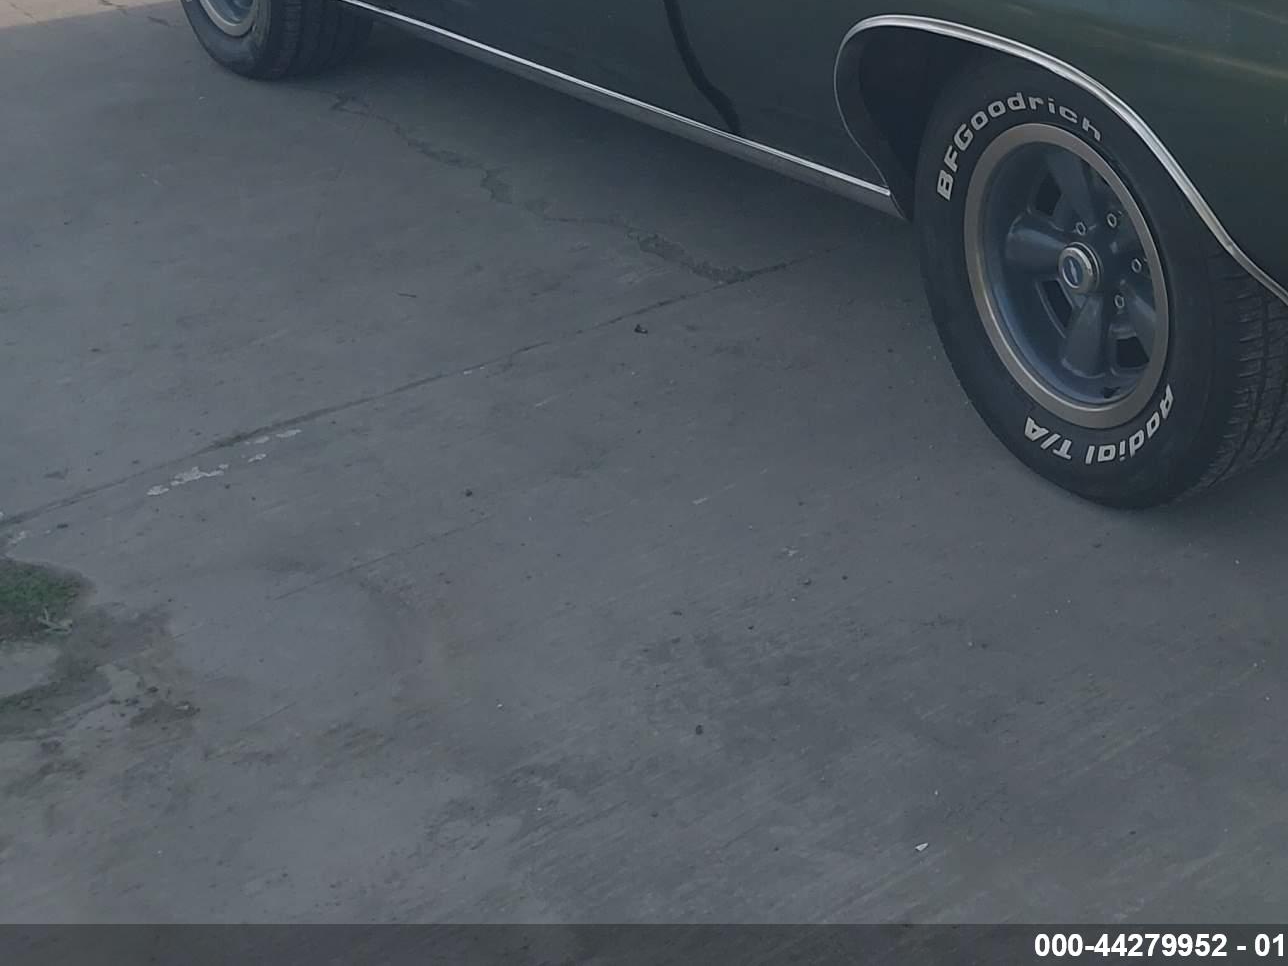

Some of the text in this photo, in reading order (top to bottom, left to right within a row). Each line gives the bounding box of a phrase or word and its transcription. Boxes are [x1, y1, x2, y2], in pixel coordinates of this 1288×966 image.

[936, 92, 1102, 201] BFGoodrich
[1024, 384, 1174, 464] Radial T/A
